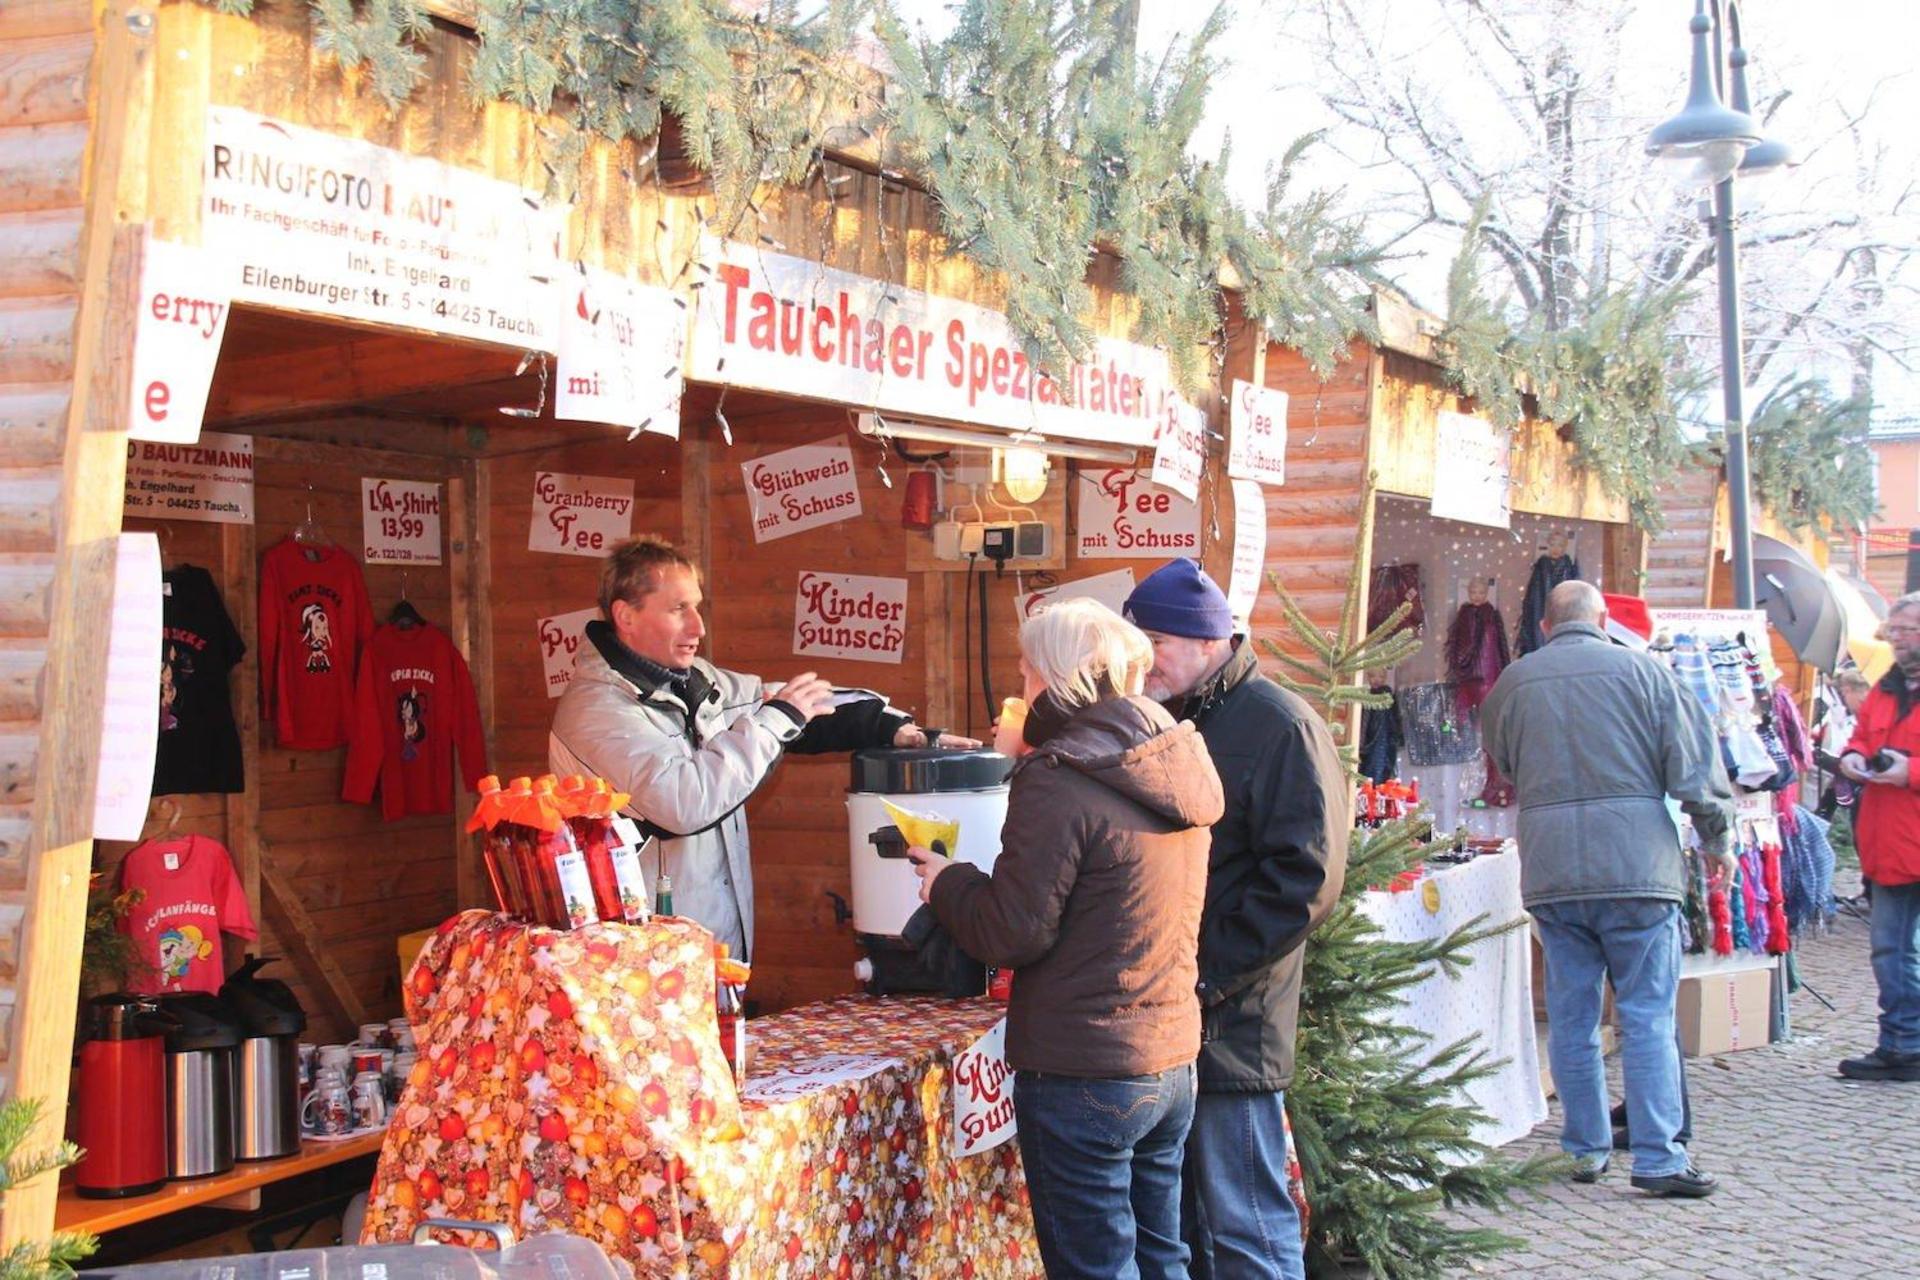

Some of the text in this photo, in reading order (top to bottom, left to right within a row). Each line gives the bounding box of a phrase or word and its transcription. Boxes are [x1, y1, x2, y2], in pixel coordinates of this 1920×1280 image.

[242, 263, 358, 304] Eilenburger
[716, 262, 934, 381] Tauchaer
[143, 443, 252, 470] BAUTZMANN
[140, 480, 195, 494] Engelhard
[536, 473, 630, 515] Cranberry
[752, 458, 850, 497] Glühwein
[1102, 467, 1170, 513] Tee
[146, 496, 153, 506] 5
[204, 500, 240, 512] Taucha
[758, 493, 856, 529] mit Schuss
[549, 505, 604, 549] Tee
[1082, 515, 1195, 549] mit Schuss
[800, 573, 904, 625] Kinder
[549, 669, 571, 685] mit
